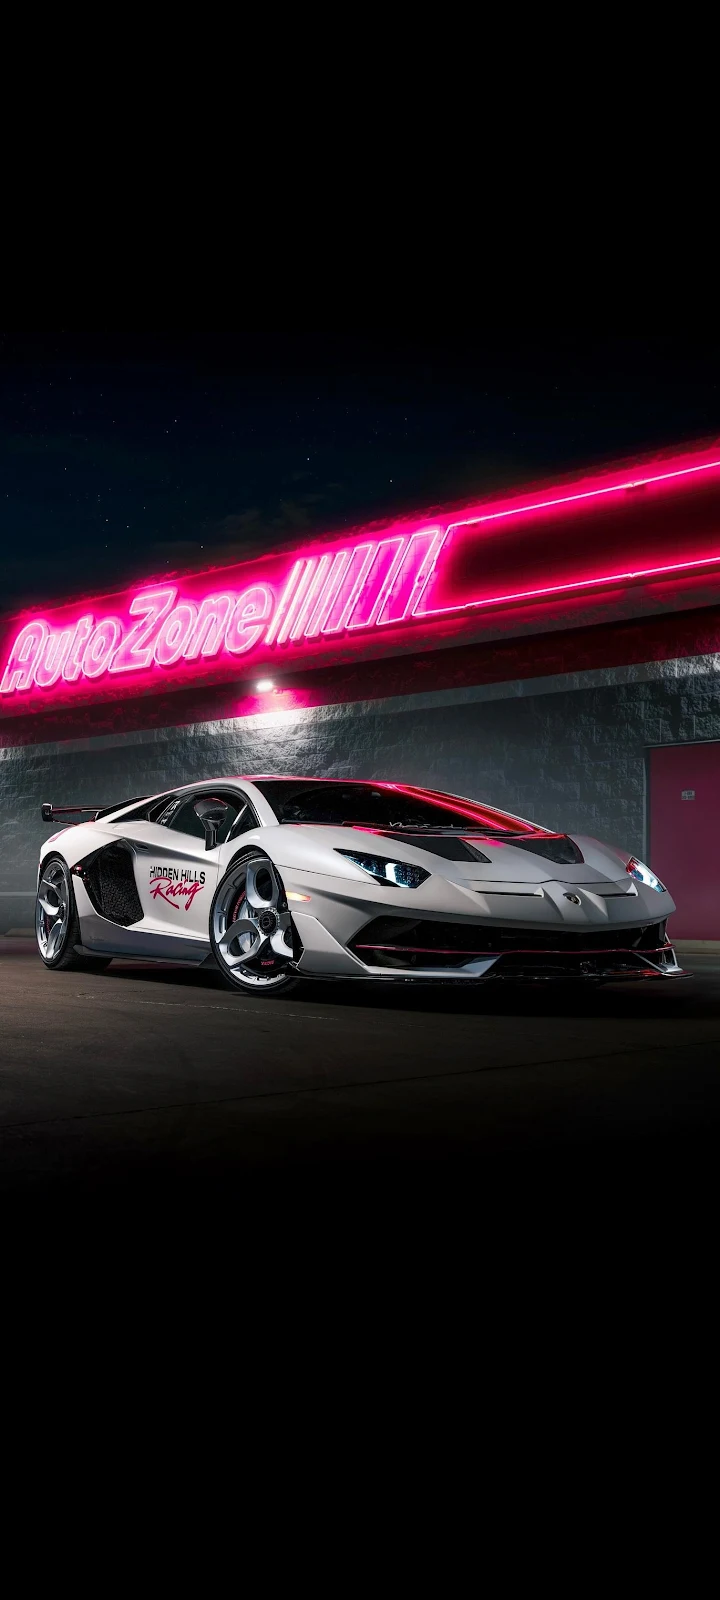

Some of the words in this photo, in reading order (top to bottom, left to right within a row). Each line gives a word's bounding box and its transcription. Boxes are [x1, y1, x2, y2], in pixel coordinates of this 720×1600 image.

[0, 587, 271, 692] AutoZone
[149, 866, 179, 881] HIDDEN
[181, 868, 206, 884] HILLS
[149, 877, 204, 911] Racing
